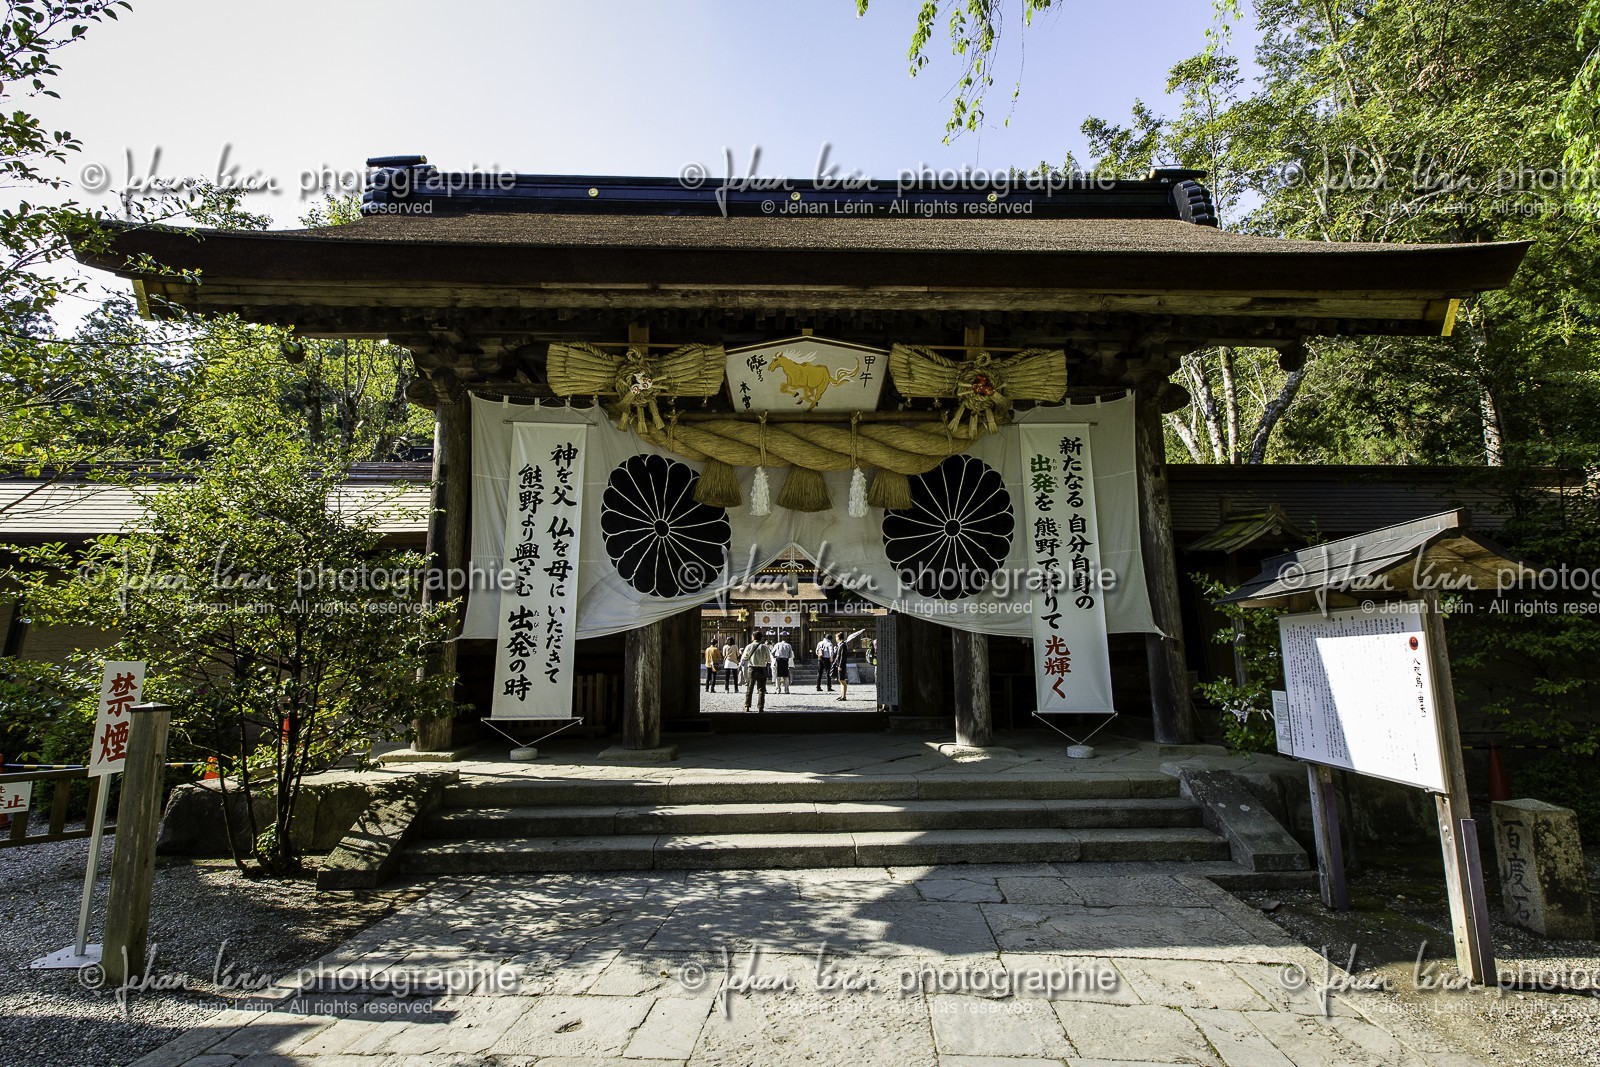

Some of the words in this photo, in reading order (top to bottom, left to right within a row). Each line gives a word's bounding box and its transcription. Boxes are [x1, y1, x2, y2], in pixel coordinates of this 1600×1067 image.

[739, 381, 751, 410] 本宮
[859, 355, 877, 389] 甲午
[97, 671, 139, 765] 禁煙
[1501, 819, 1533, 922] 百度石
